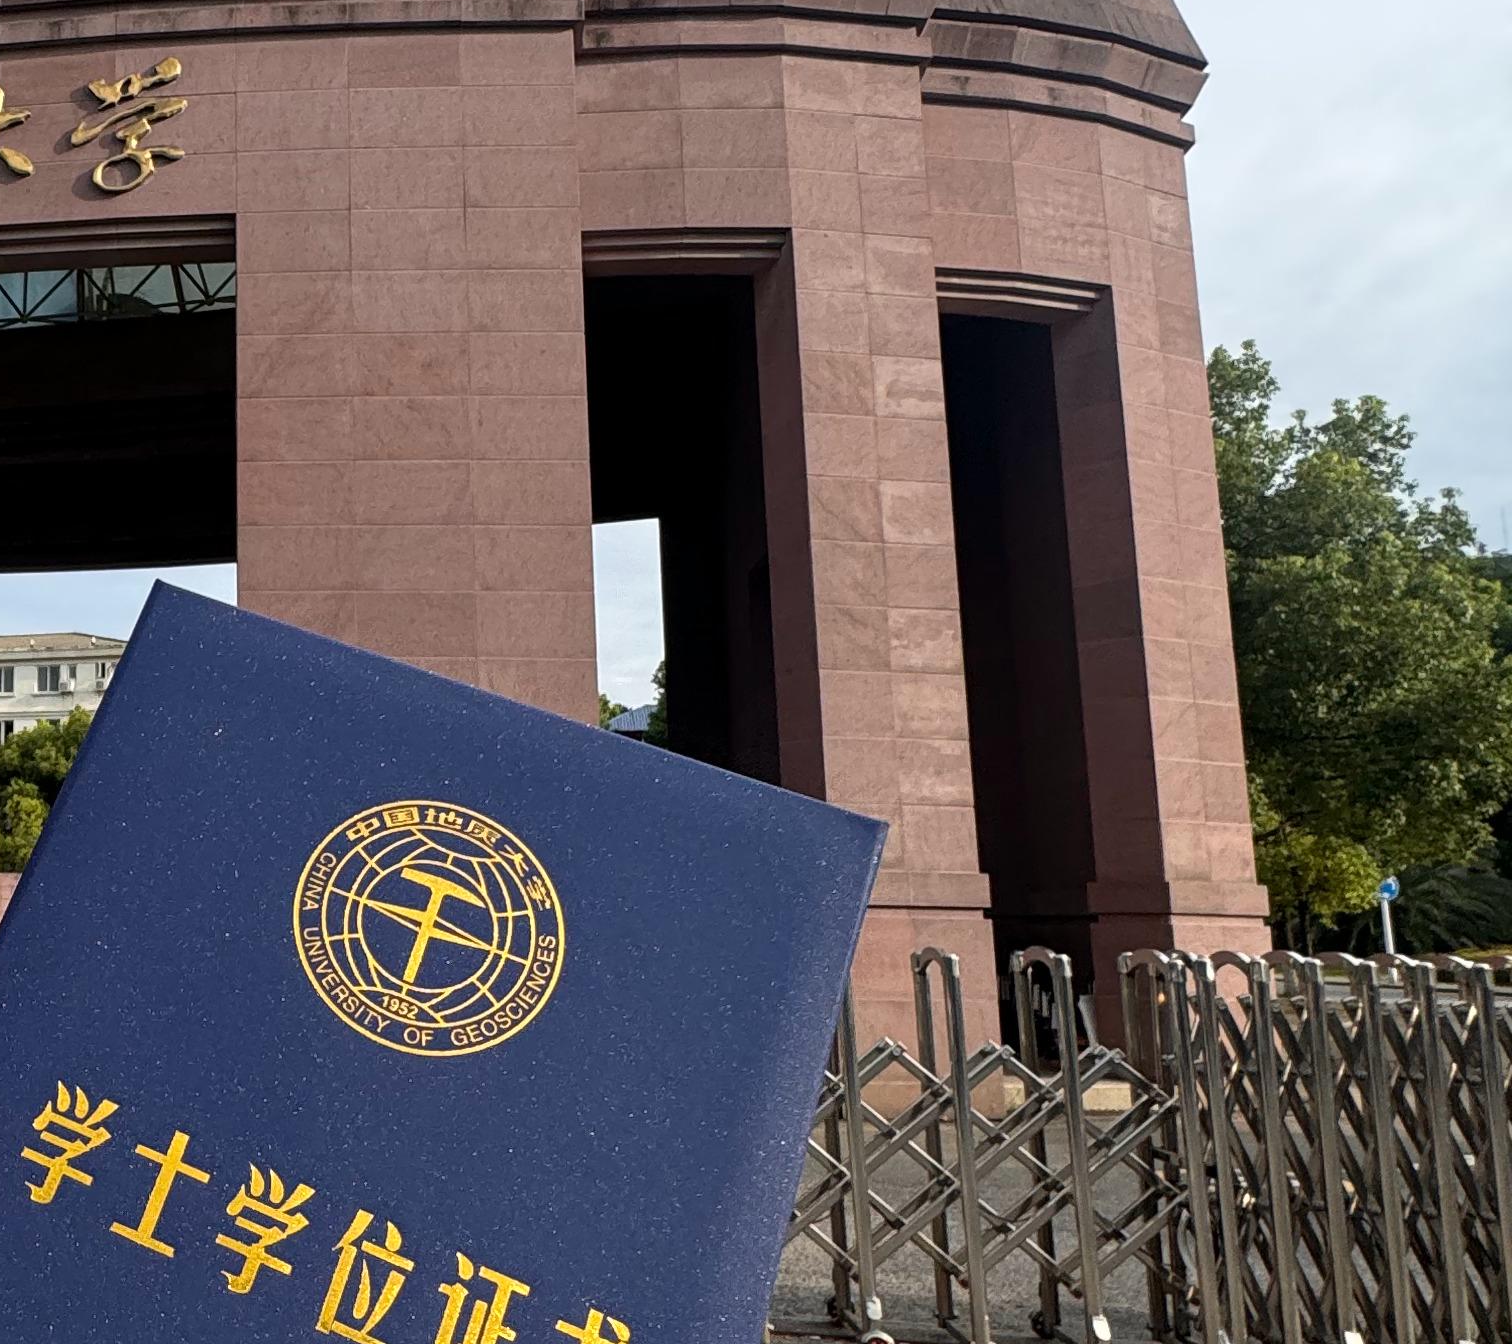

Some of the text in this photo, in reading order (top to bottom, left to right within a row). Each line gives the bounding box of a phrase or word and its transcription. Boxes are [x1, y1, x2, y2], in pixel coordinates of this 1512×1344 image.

[345, 806, 552, 912] 中国地质大学
[302, 852, 556, 1047] CHINA UNIVERSITY OF GEOSCIENCES
[381, 995, 419, 1020] 1952
